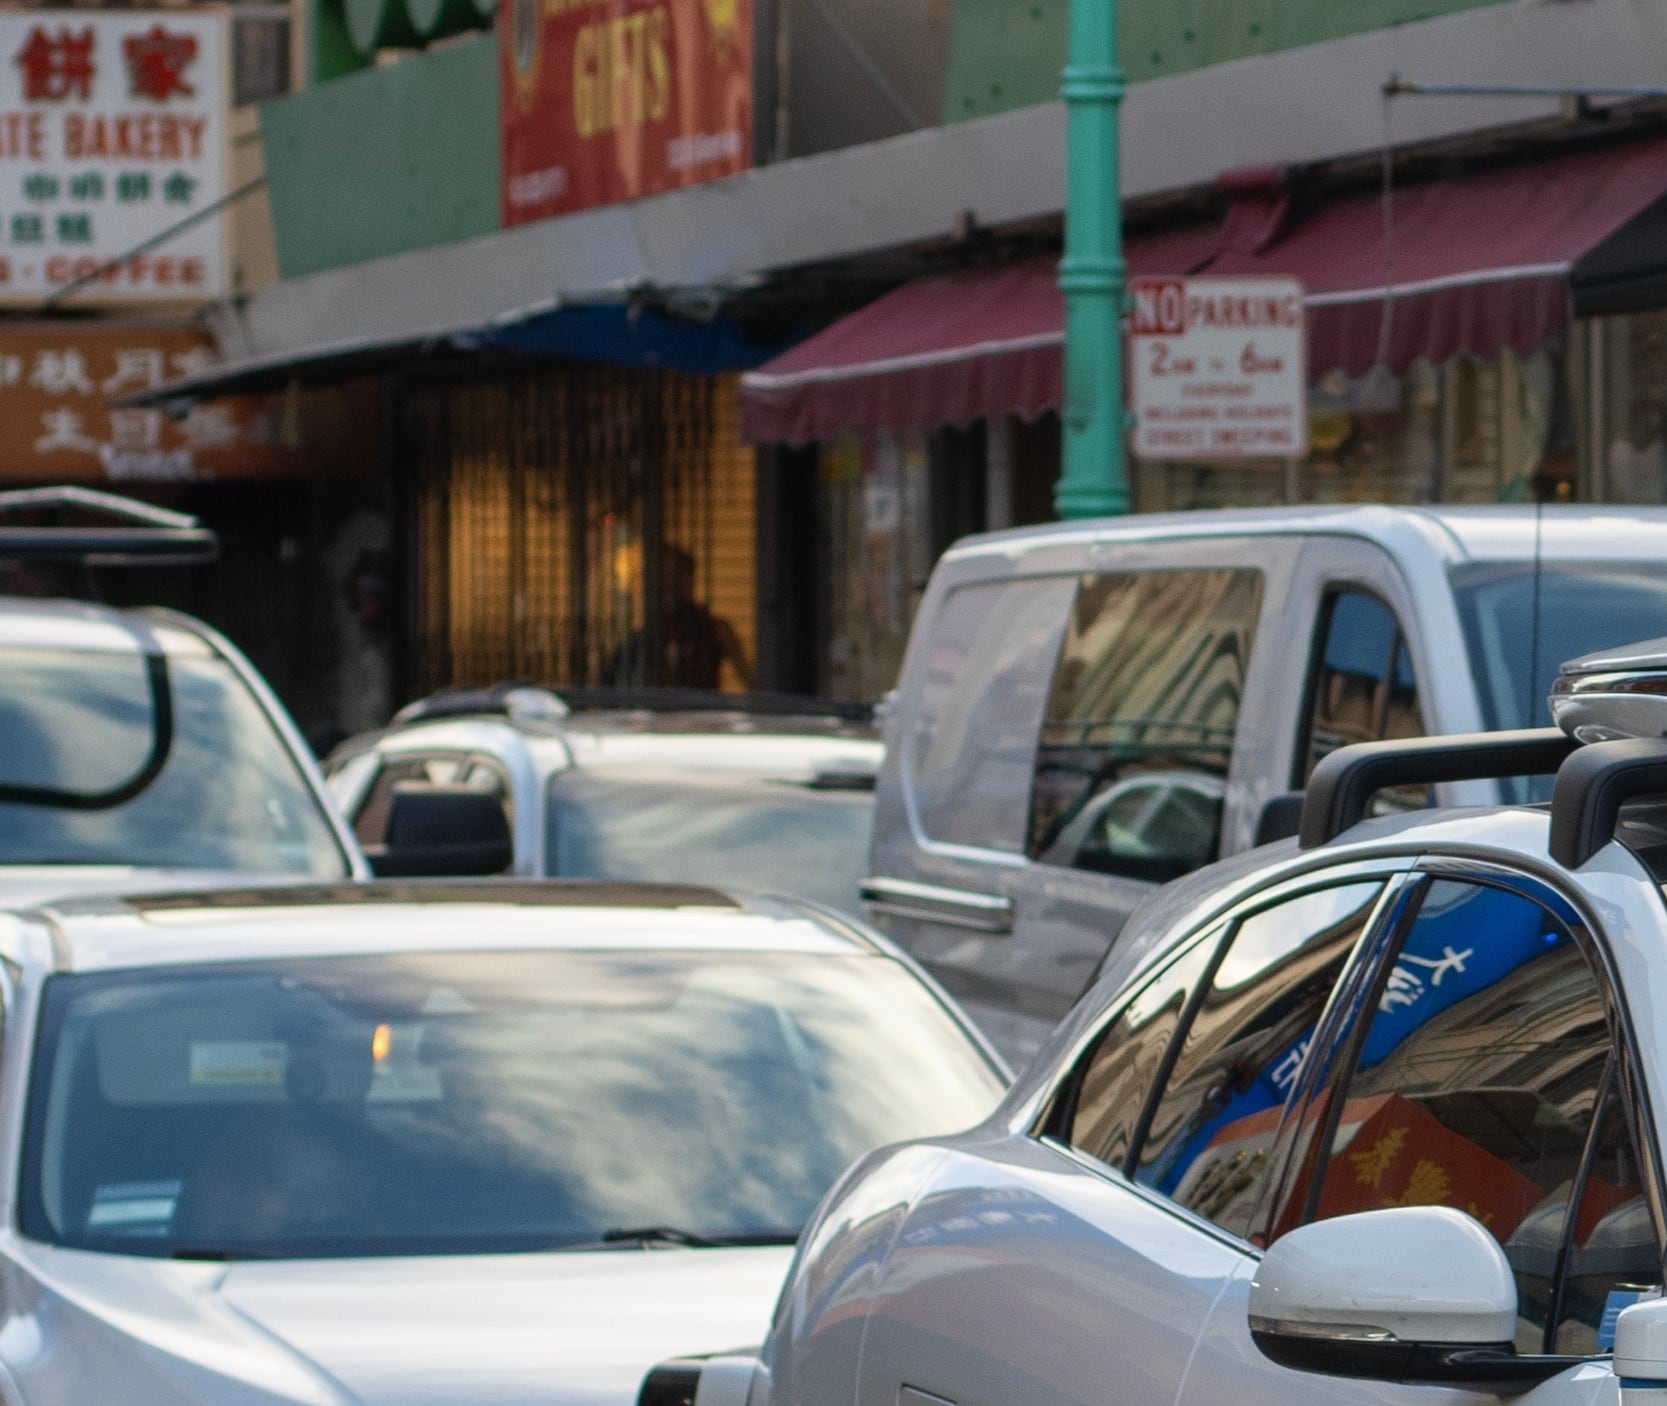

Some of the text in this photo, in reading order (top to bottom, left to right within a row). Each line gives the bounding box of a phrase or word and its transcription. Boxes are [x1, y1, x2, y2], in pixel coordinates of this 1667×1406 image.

[575, 6, 669, 140] GIFTS
[64, 112, 206, 161] BAKERY
[45, 256, 203, 284] COFFEE
[1135, 287, 1297, 330] NO PARKING
